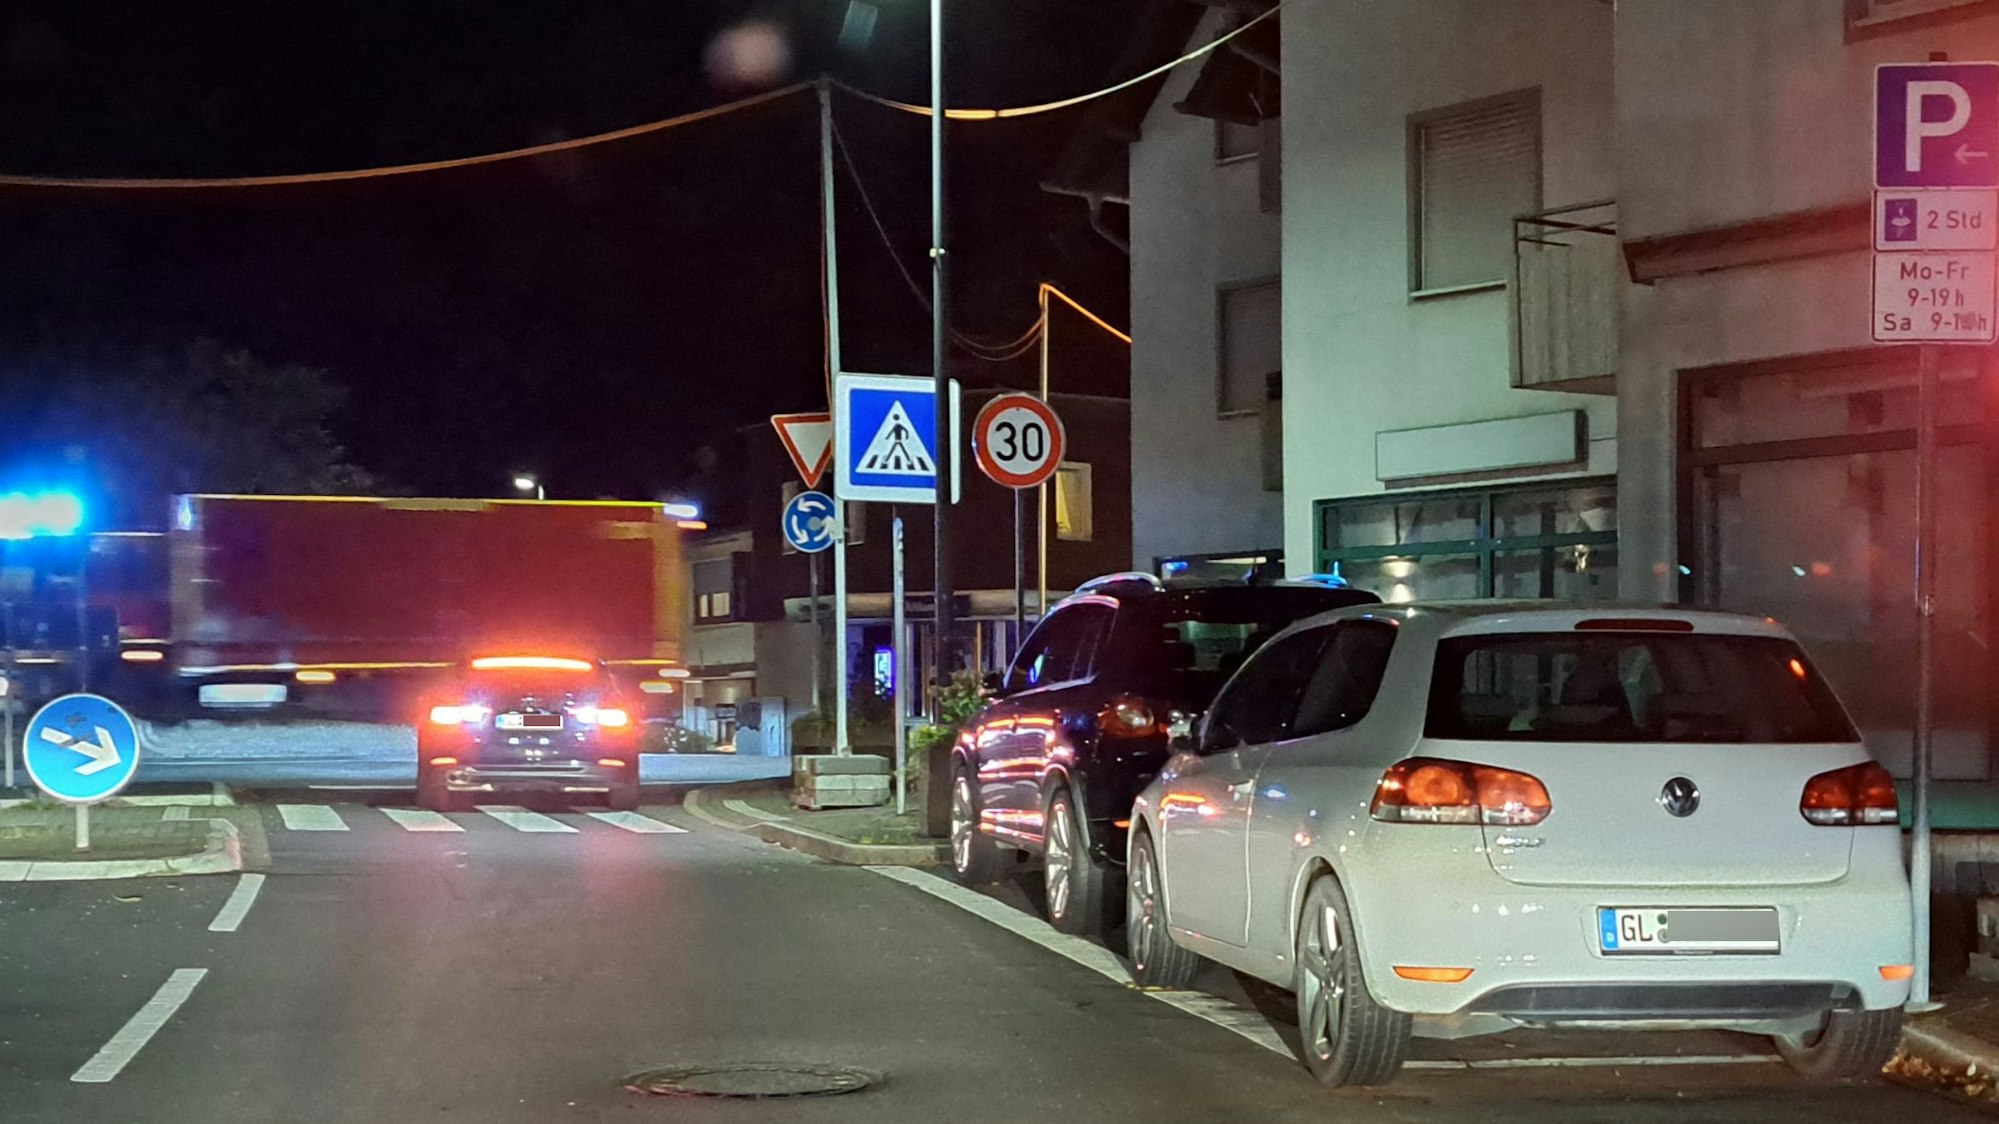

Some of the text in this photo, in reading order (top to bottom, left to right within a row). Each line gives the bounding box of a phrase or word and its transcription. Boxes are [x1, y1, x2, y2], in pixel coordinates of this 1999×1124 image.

[1905, 80, 1972, 172] P
[1927, 210, 1982, 229] 2 Std
[1900, 261, 1970, 280] Mo-Fr
[1883, 313, 1912, 331] Sa
[995, 421, 1044, 462] 30
[1621, 914, 1653, 942] GL
